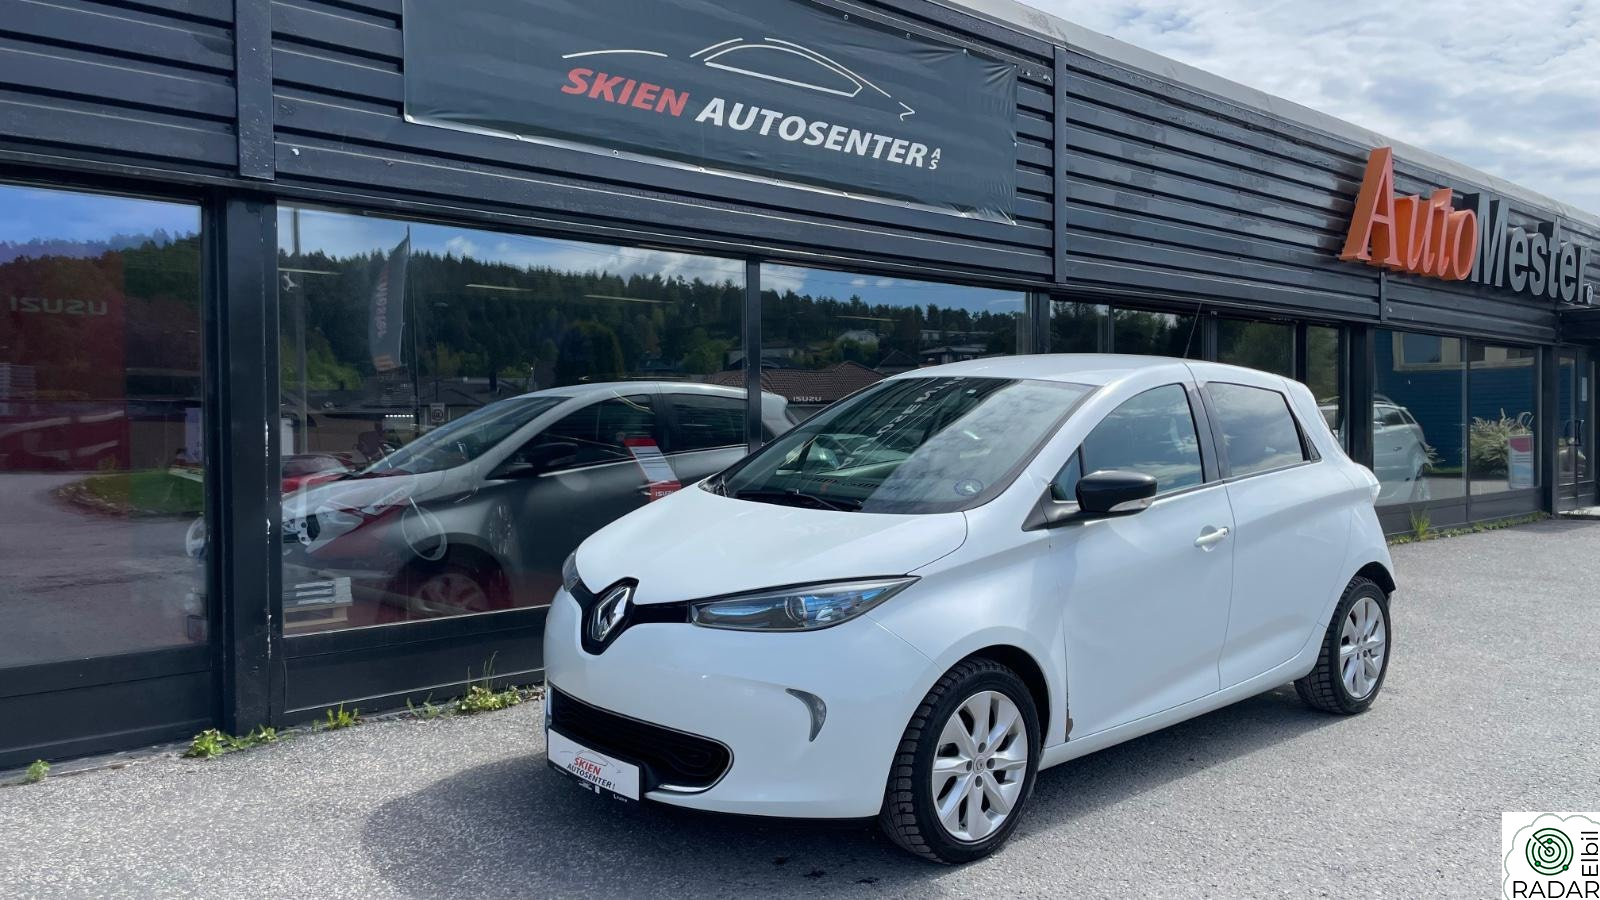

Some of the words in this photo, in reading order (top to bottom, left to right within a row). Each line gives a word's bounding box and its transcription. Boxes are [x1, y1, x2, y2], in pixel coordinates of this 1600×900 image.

[561, 67, 690, 118] SKIEN
[695, 97, 929, 168] AUTOSENTER
[1338, 146, 1594, 306] AutoMester
[10, 296, 108, 318] ISUZU
[574, 757, 602, 776] SKIEN
